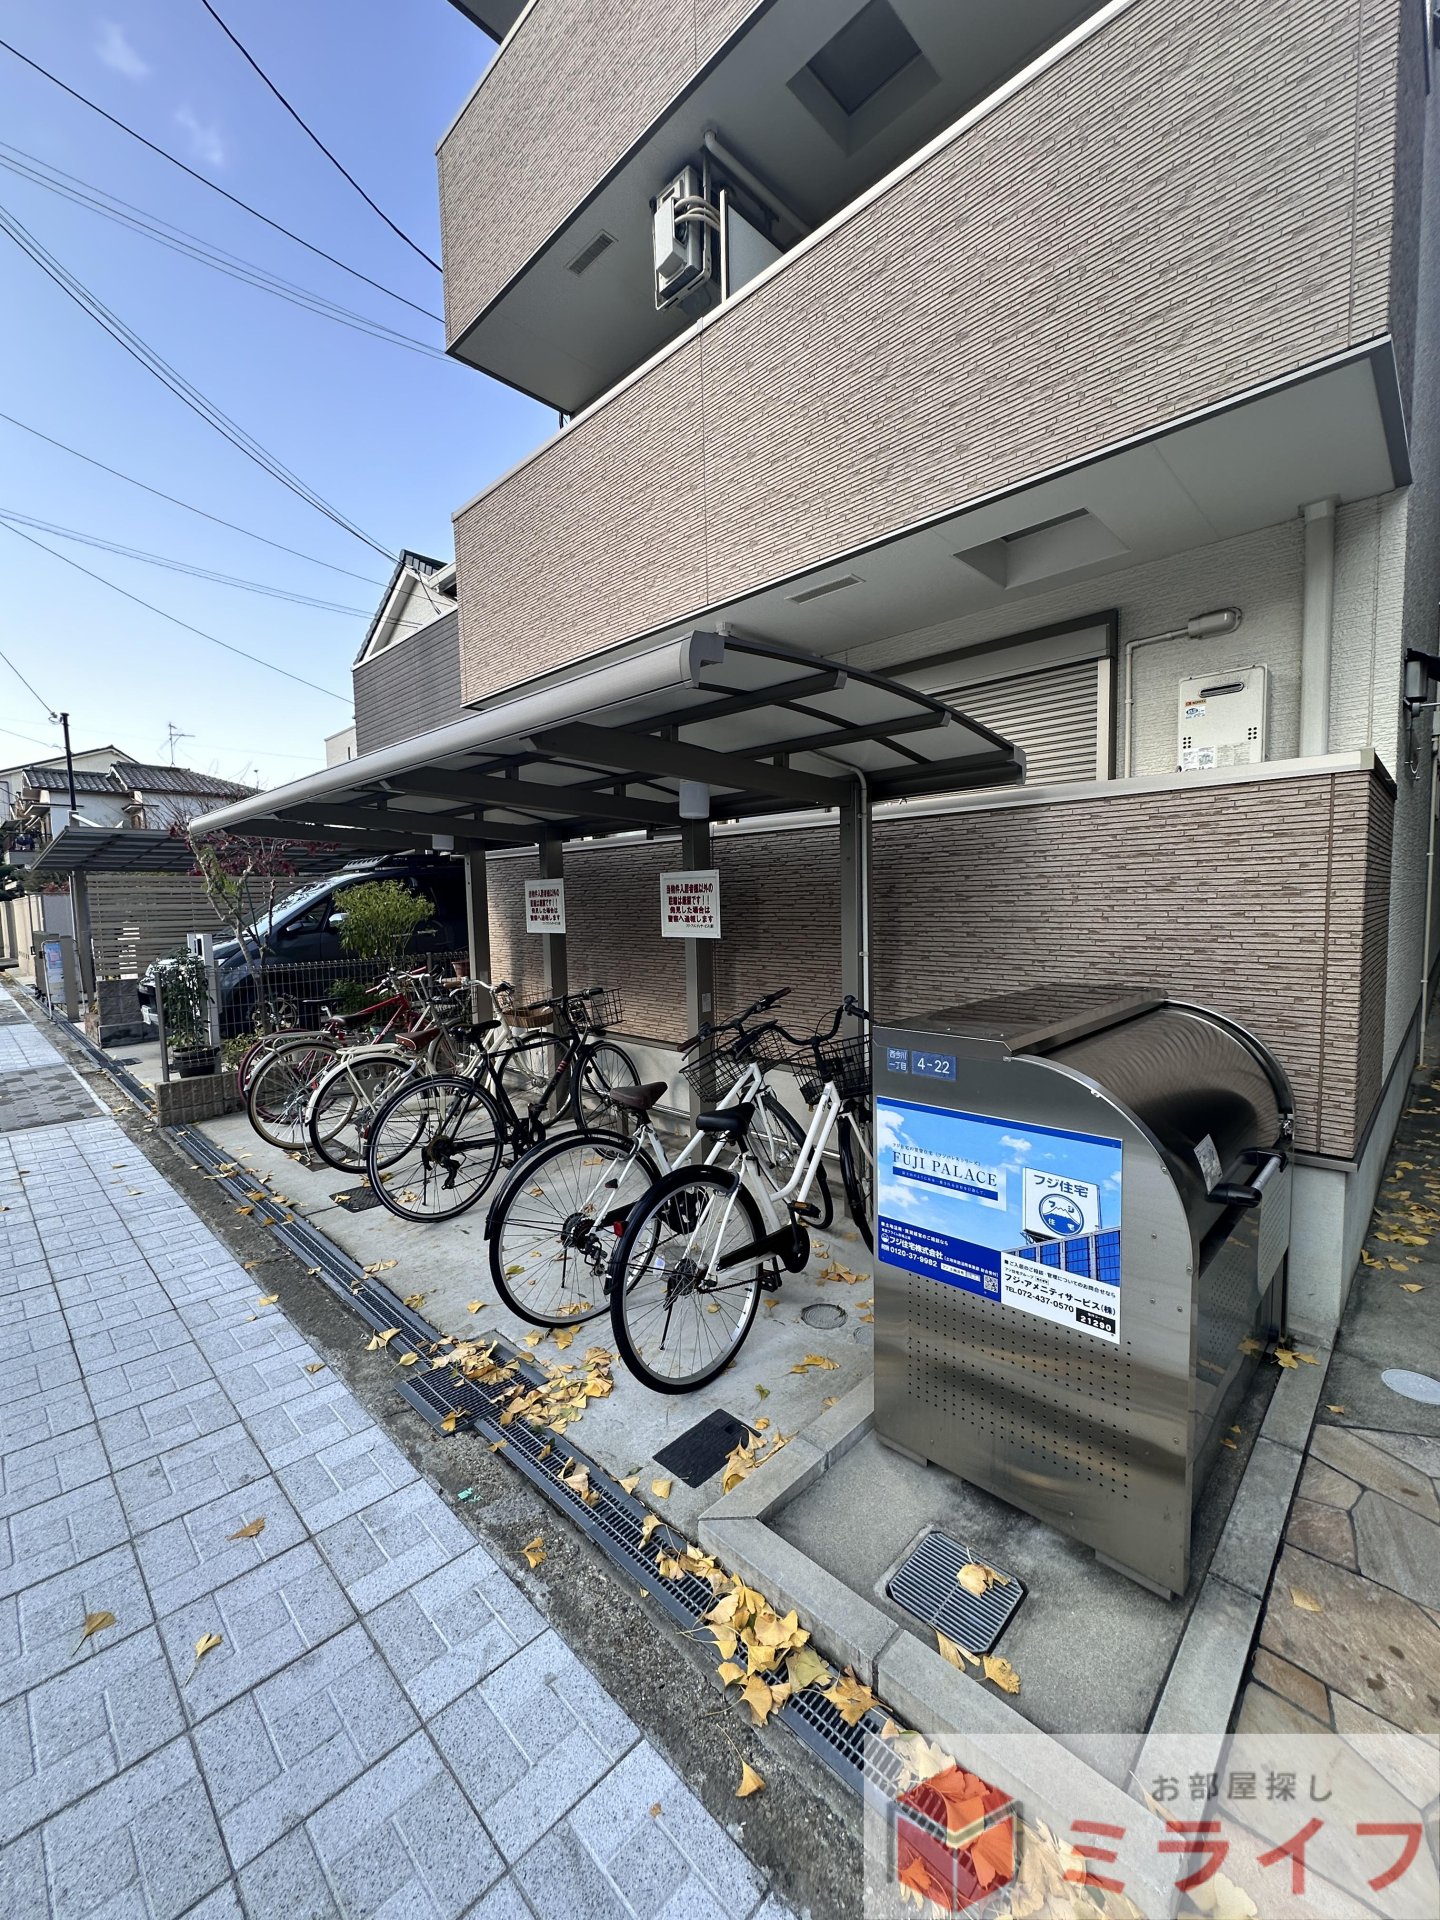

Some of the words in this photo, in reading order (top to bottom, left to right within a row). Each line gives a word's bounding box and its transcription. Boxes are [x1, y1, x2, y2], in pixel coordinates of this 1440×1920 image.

[670, 906, 710, 914] 発見した場合は
[668, 915, 714, 923] 警察へ通報します
[888, 1061, 907, 1071] 一丁目
[917, 1057, 950, 1074] 4-22
[892, 1150, 925, 1169] FUJI
[932, 1160, 997, 1187] PALACE
[1034, 1174, 1089, 1198] フジ住宅
[889, 1235, 943, 1260] フジ住宅株式会社
[1080, 1315, 1112, 1332] 21290
